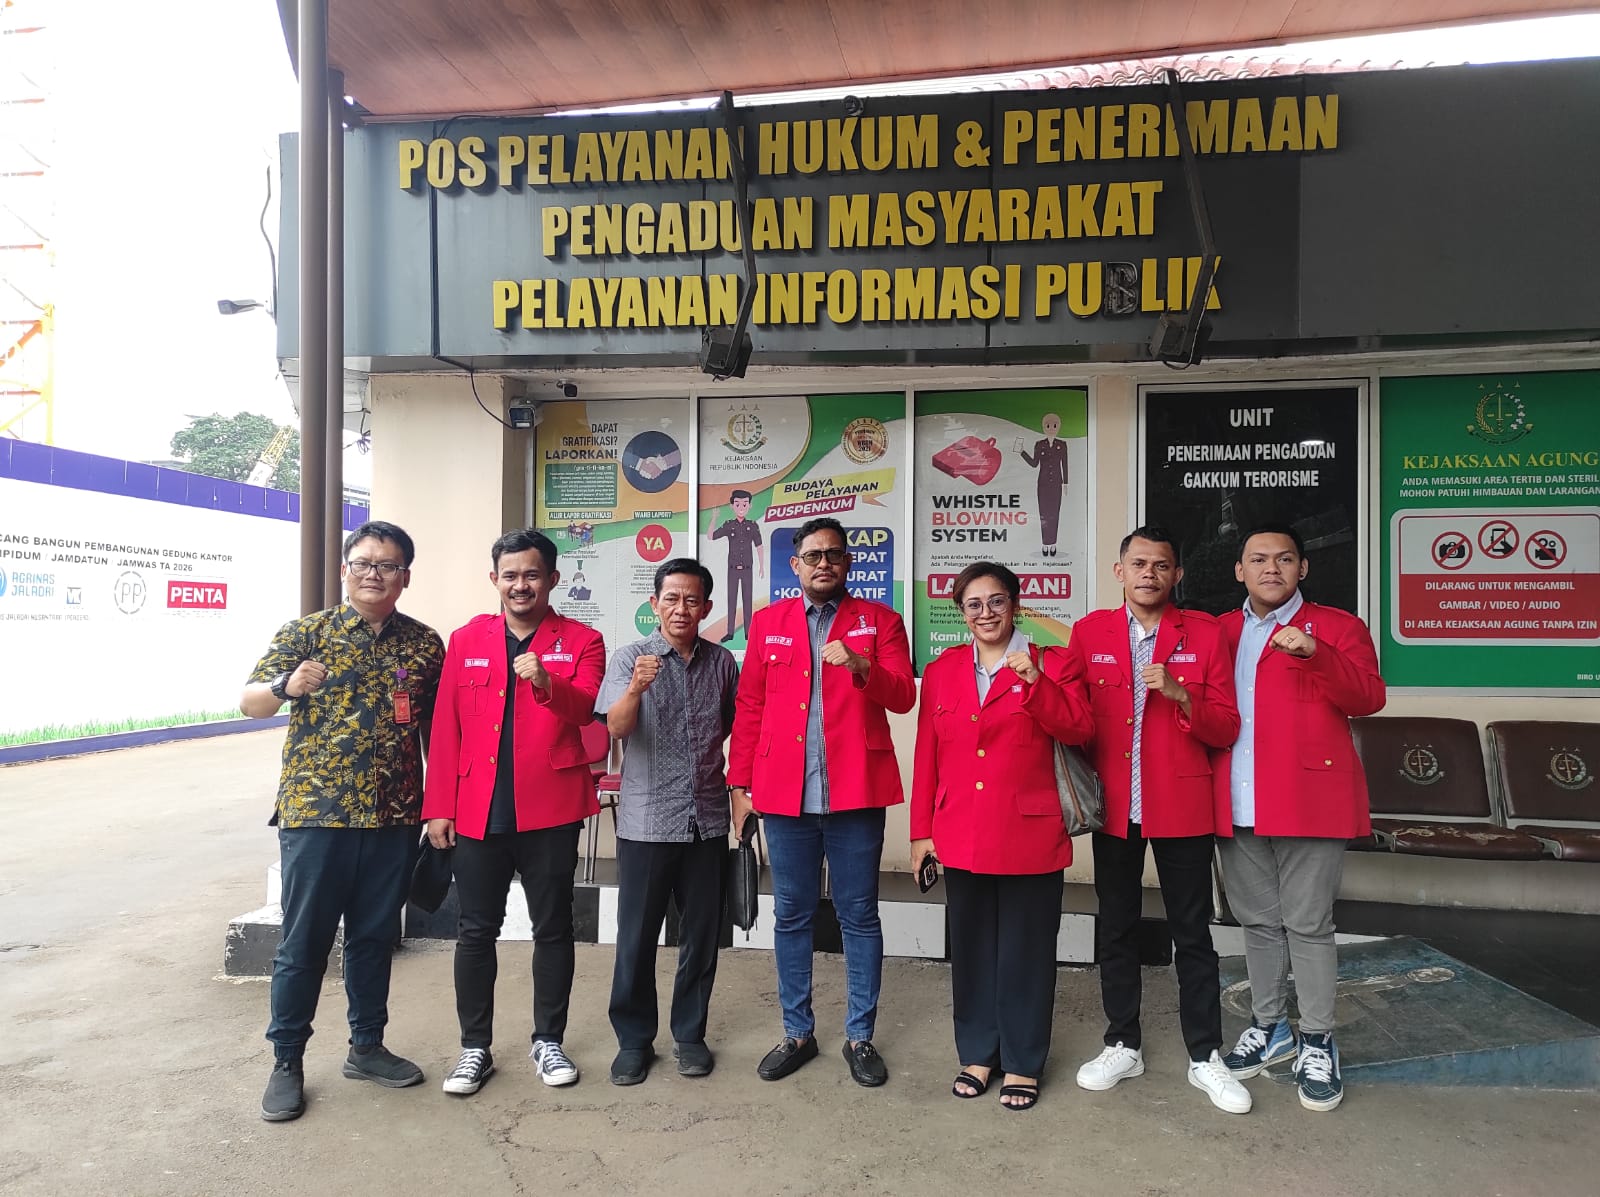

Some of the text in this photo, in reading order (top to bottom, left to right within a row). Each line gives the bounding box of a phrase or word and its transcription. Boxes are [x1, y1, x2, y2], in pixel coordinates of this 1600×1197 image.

[399, 136, 487, 189] POS
[758, 113, 939, 176] HUKUM
[953, 121, 991, 168] &
[1003, 95, 1339, 165] PENERIMAAN
[542, 180, 1164, 257] PENGADUAN MASYARAKAT
[493, 272, 739, 329] PELAYANAN
[752, 264, 1022, 326] INFORMASI
[1230, 408, 1274, 428] UNIT
[592, 423, 618, 433] DAPAT
[562, 436, 618, 446] GRATIFIKASI?
[546, 449, 618, 460] LAPORKAN!
[1168, 442, 1335, 462] PENERIMAAN PENGADUAN
[1402, 452, 1598, 470] KEJAKSAAN AGUNG
[784, 478, 833, 493] BUDAYA
[1184, 470, 1319, 488] GAKKUM TERORISME
[1402, 474, 1600, 486] ANDA MEMASUKI AREA TERTIB DAN STERIL
[806, 482, 878, 499] PELAYANAN
[1400, 486, 1600, 497] MOHON PATUHI HIMBAUAN DAN LARANGAN
[767, 498, 853, 519] PUSPENKUM
[932, 496, 1020, 509] WHISTLE
[932, 512, 1028, 526] BLOWING
[846, 530, 888, 547] KAP
[932, 529, 1008, 542] SYSTEM
[0, 534, 232, 562] ANG BANGUN PEMBANGUNAN GEDUNG KANTOR
[644, 537, 665, 550] YA
[0, 549, 41, 560] PIDUM
[51, 553, 108, 565] JAMDATUN
[117, 559, 157, 569] JAMWAS
[160, 562, 170, 570] TA
[852, 552, 887, 563] EPAT
[12, 572, 55, 584] AGRINAS
[847, 570, 887, 582] URAT
[11, 585, 54, 597] JALADRI
[932, 578, 1067, 594] LAKAN!
[1425, 581, 1575, 590] DILARANG UNTUK MENGAMBIL
[121, 582, 142, 604] PP
[170, 586, 225, 604] PENTA
[1439, 600, 1560, 610] GAMBAR / VIDEO / AUDIO
[638, 616, 660, 624] TIDA
[1405, 619, 1597, 629] DI AREA KEJAKSAAN AGUNG TANPA IZIN
[930, 632, 960, 642] Kami
